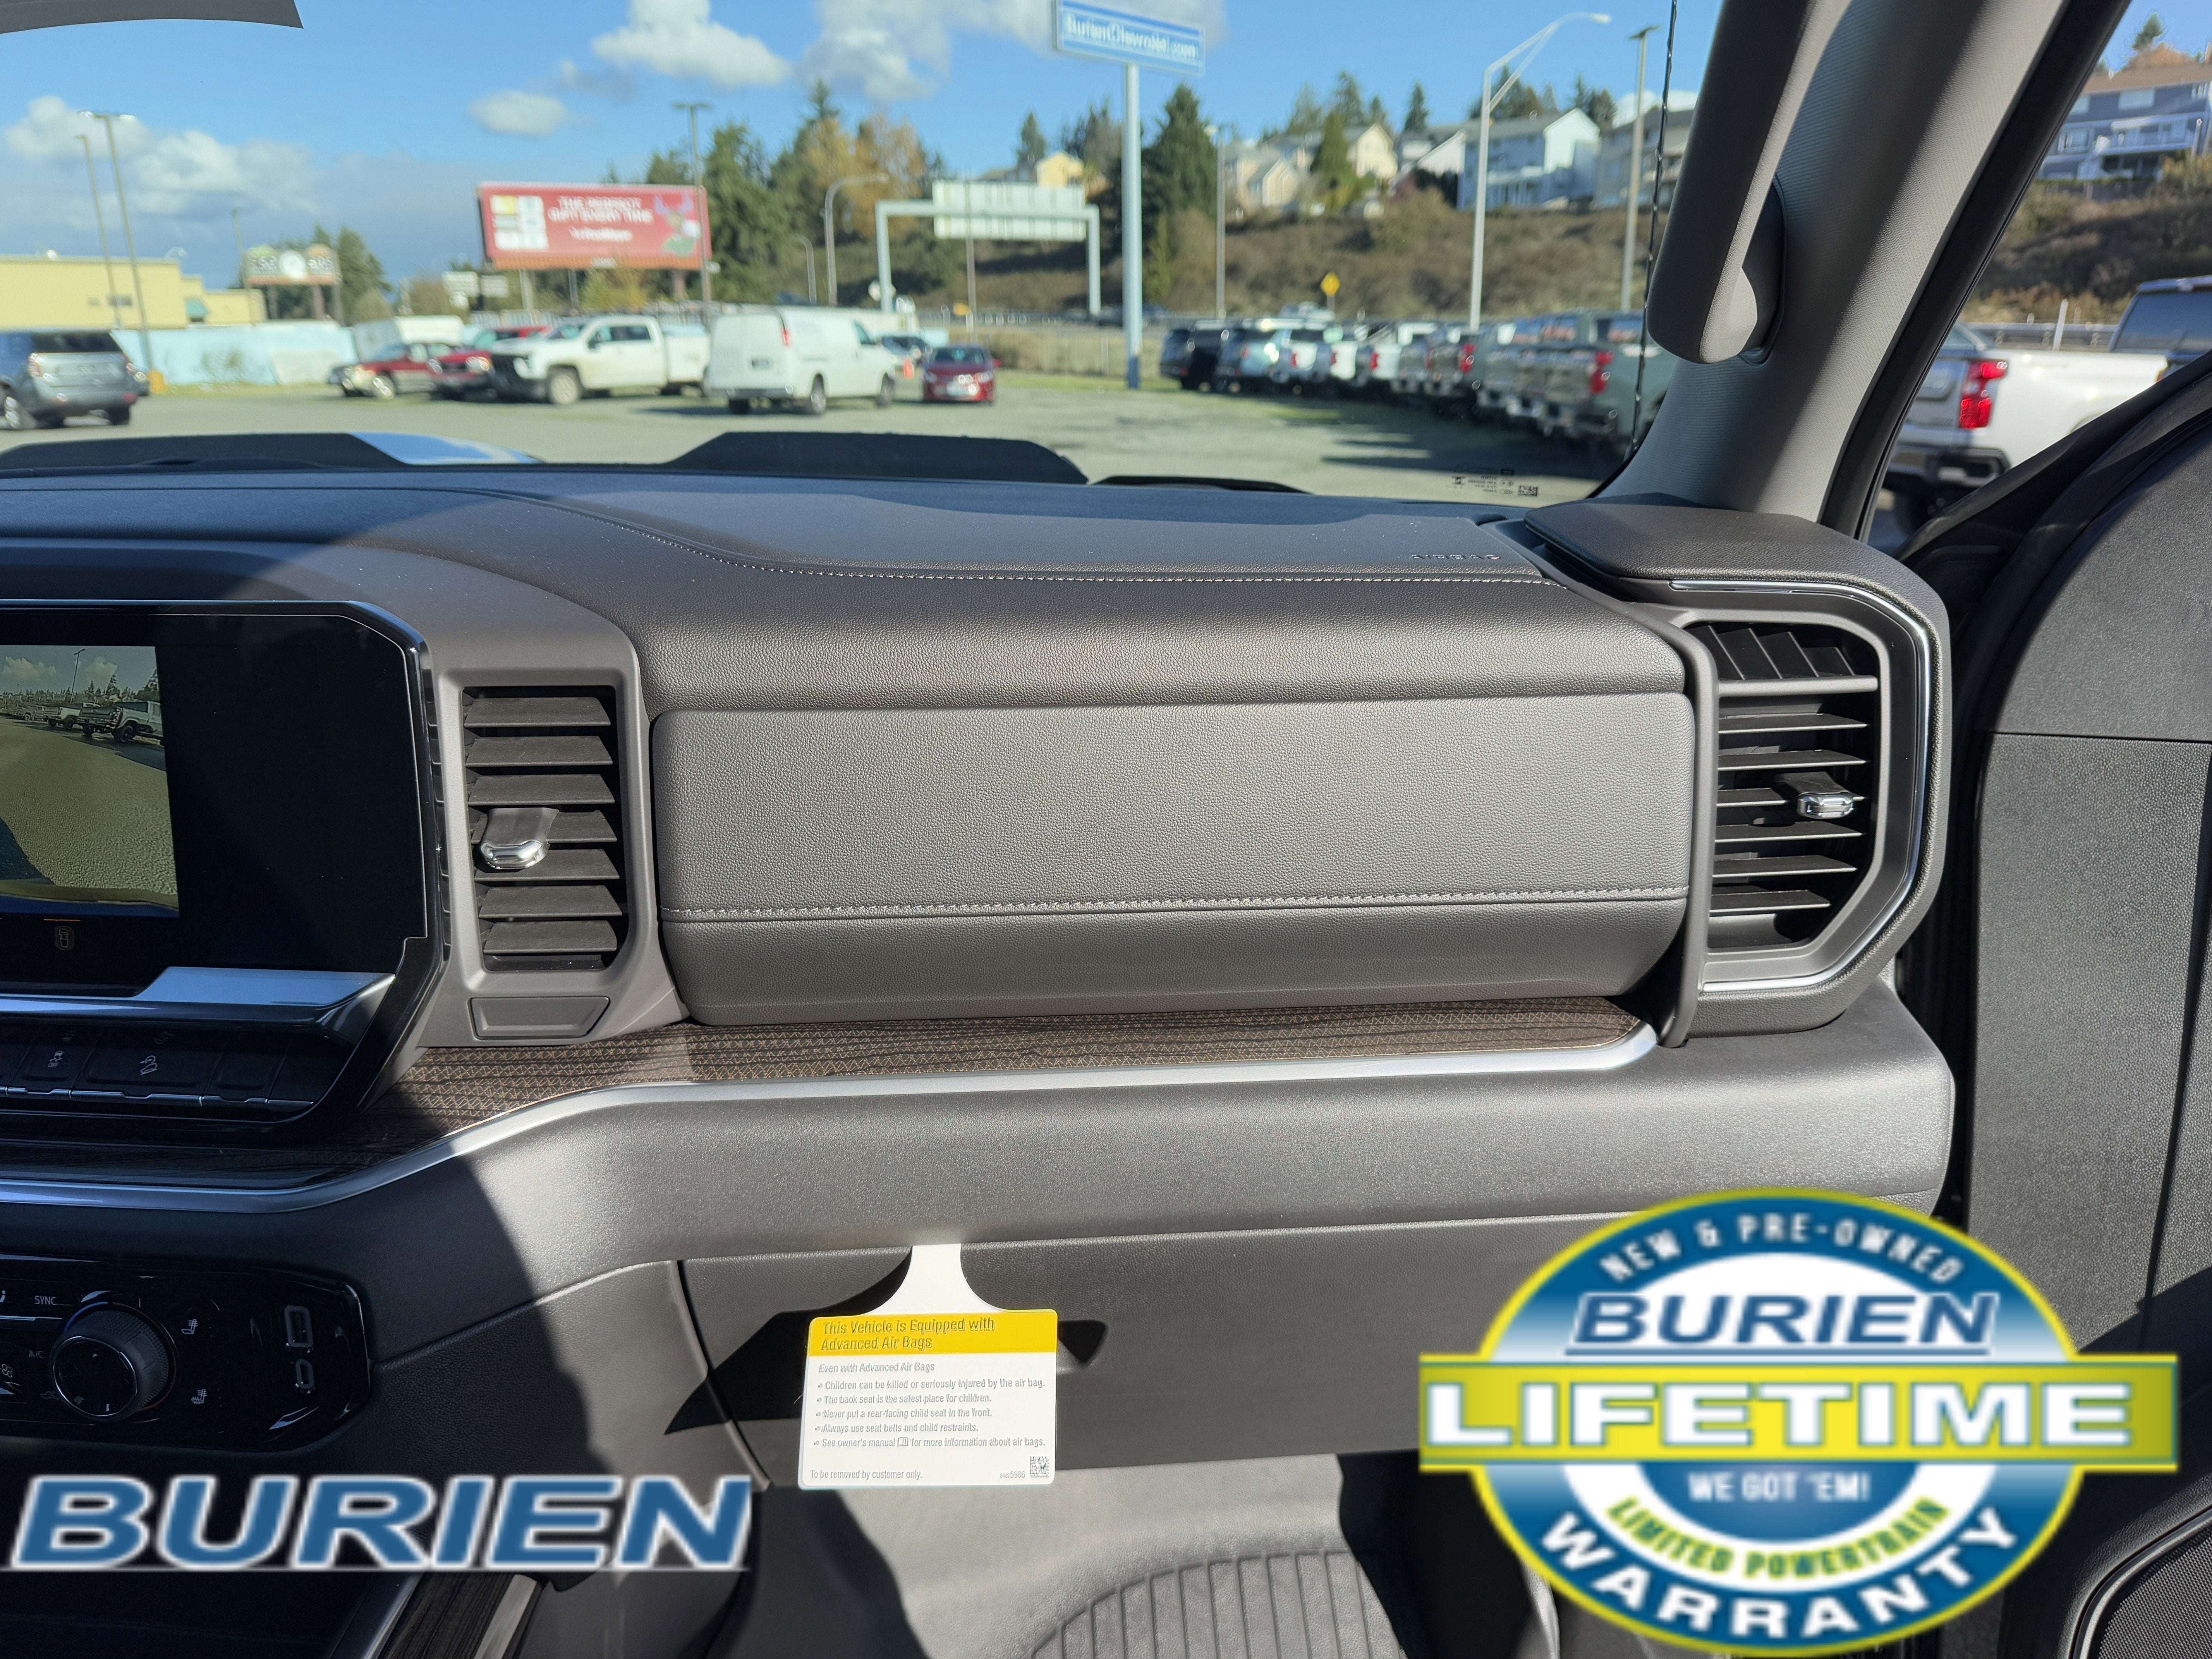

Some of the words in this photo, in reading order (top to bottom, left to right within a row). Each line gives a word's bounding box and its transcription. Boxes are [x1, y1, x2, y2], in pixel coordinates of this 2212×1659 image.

[35, 1295, 57, 1305] SYNC
[823, 1321, 847, 1334] This
[851, 1320, 893, 1333] Vehicle
[896, 1320, 907, 1333] is
[910, 1317, 965, 1335] Equipped
[969, 1317, 995, 1331] with
[821, 1337, 879, 1351] Advanced
[882, 1336, 900, 1349] Air
[903, 1336, 933, 1351] Bags
[29, 1350, 44, 1358] A/C
[819, 1364, 838, 1372] Even
[841, 1363, 857, 1372] with
[859, 1362, 899, 1372] Advanced
[900, 1362, 912, 1371] Air
[914, 1362, 934, 1372] Bags
[825, 1381, 857, 1389] Children
[875, 1381, 884, 1389] be
[886, 1380, 908, 1388] killed
[921, 1379, 956, 1389] seriously
[958, 1379, 986, 1389] injured
[988, 1379, 997, 1389] by
[1000, 1378, 1012, 1387] the
[1015, 1378, 1026, 1387] air
[1028, 1377, 1045, 1389] bag.
[824, 1395, 837, 1404] The
[839, 1395, 857, 1403] back
[859, 1395, 875, 1403] seat
[877, 1395, 883, 1403] is
[885, 1395, 897, 1403] the
[899, 1394, 922, 1403] safest
[923, 1394, 944, 1405] place
[946, 1394, 957, 1402] for
[959, 1393, 991, 1402] children.
[823, 1410, 845, 1418] Never
[846, 1410, 859, 1419] put
[867, 1409, 908, 1419] rear-facing
[910, 1408, 928, 1417] child
[930, 1408, 946, 1417] seat
[949, 1408, 955, 1417] in
[958, 1408, 970, 1417] the
[972, 1408, 992, 1417] front.
[821, 1424, 849, 1434] Always
[866, 1424, 882, 1432] seat
[884, 1424, 902, 1432] belts
[903, 1424, 917, 1432] and
[920, 1423, 938, 1432] child
[939, 1423, 978, 1432] restraints.
[822, 1438, 835, 1447] See
[838, 1438, 866, 1447] owner's
[868, 1438, 895, 1447] manual
[910, 1438, 922, 1446] for
[944, 1437, 987, 1446] information
[989, 1437, 1010, 1446] about
[1013, 1437, 1023, 1446] air
[1025, 1437, 1045, 1448] bags.
[811, 1470, 818, 1478] To
[820, 1470, 828, 1478] be
[830, 1470, 860, 1478] removed
[862, 1470, 870, 1480] by
[872, 1470, 903, 1479] customer
[906, 1470, 922, 1480] only.
